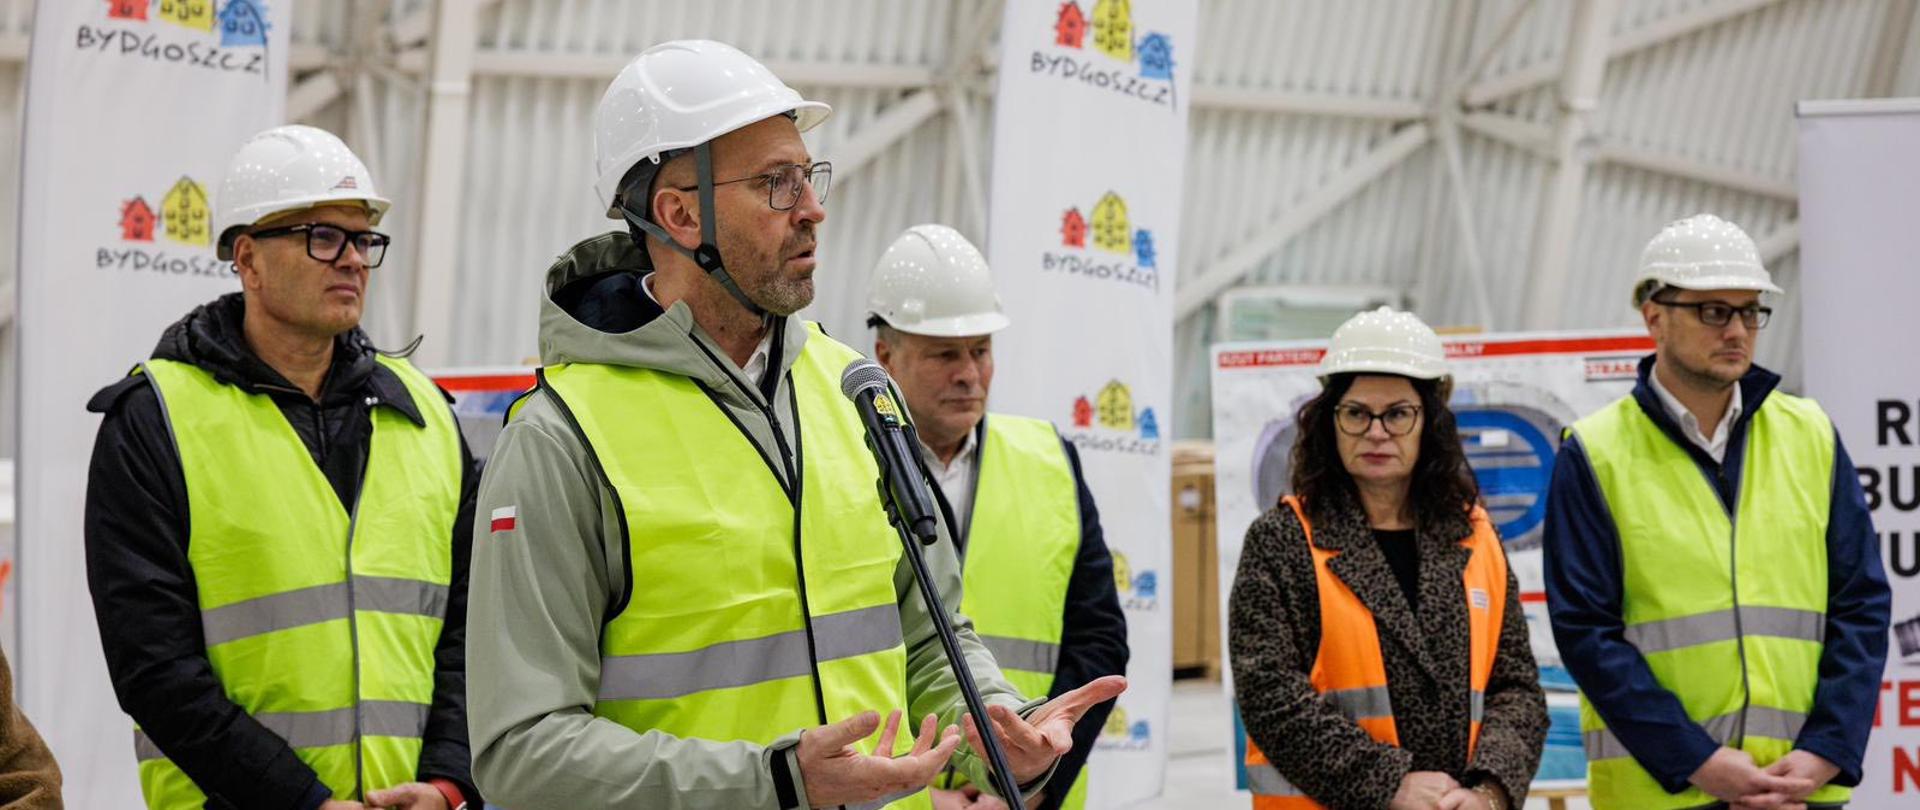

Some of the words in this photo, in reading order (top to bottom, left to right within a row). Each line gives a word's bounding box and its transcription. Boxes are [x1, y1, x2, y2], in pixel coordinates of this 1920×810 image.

[76, 25, 262, 74] BYDGOSZCZ
[1031, 51, 1168, 104] BYDGOSZCZ
[96, 248, 240, 278] BYDGOSZC
